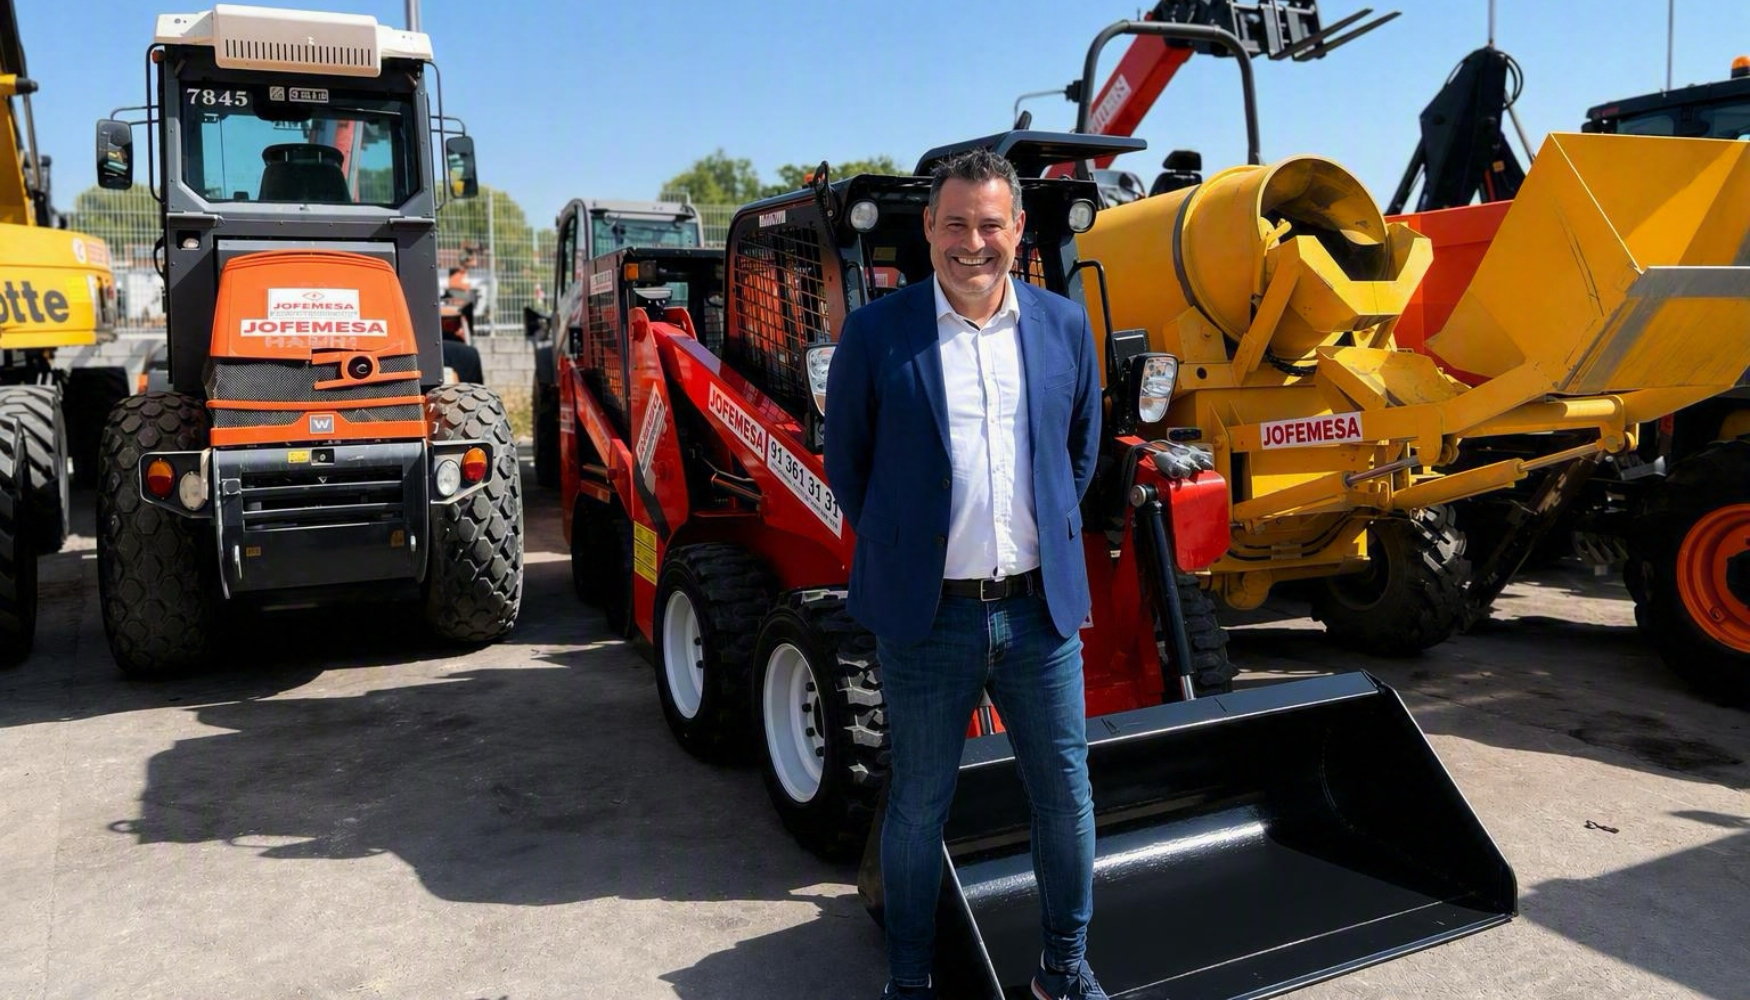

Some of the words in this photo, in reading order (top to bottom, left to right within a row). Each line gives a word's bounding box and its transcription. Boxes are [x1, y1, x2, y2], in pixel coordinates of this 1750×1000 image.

[186, 88, 248, 106] 7845
[273, 302, 354, 310] JOFEMESA
[244, 321, 384, 333] JOFEMESA
[314, 419, 330, 429] W
[1263, 416, 1360, 446] JOFEMESA
[710, 389, 764, 453] JOFEMESA
[770, 441, 782, 465] 91
[785, 455, 804, 488] 361
[808, 476, 821, 503] 31
[824, 491, 838, 519] 31
